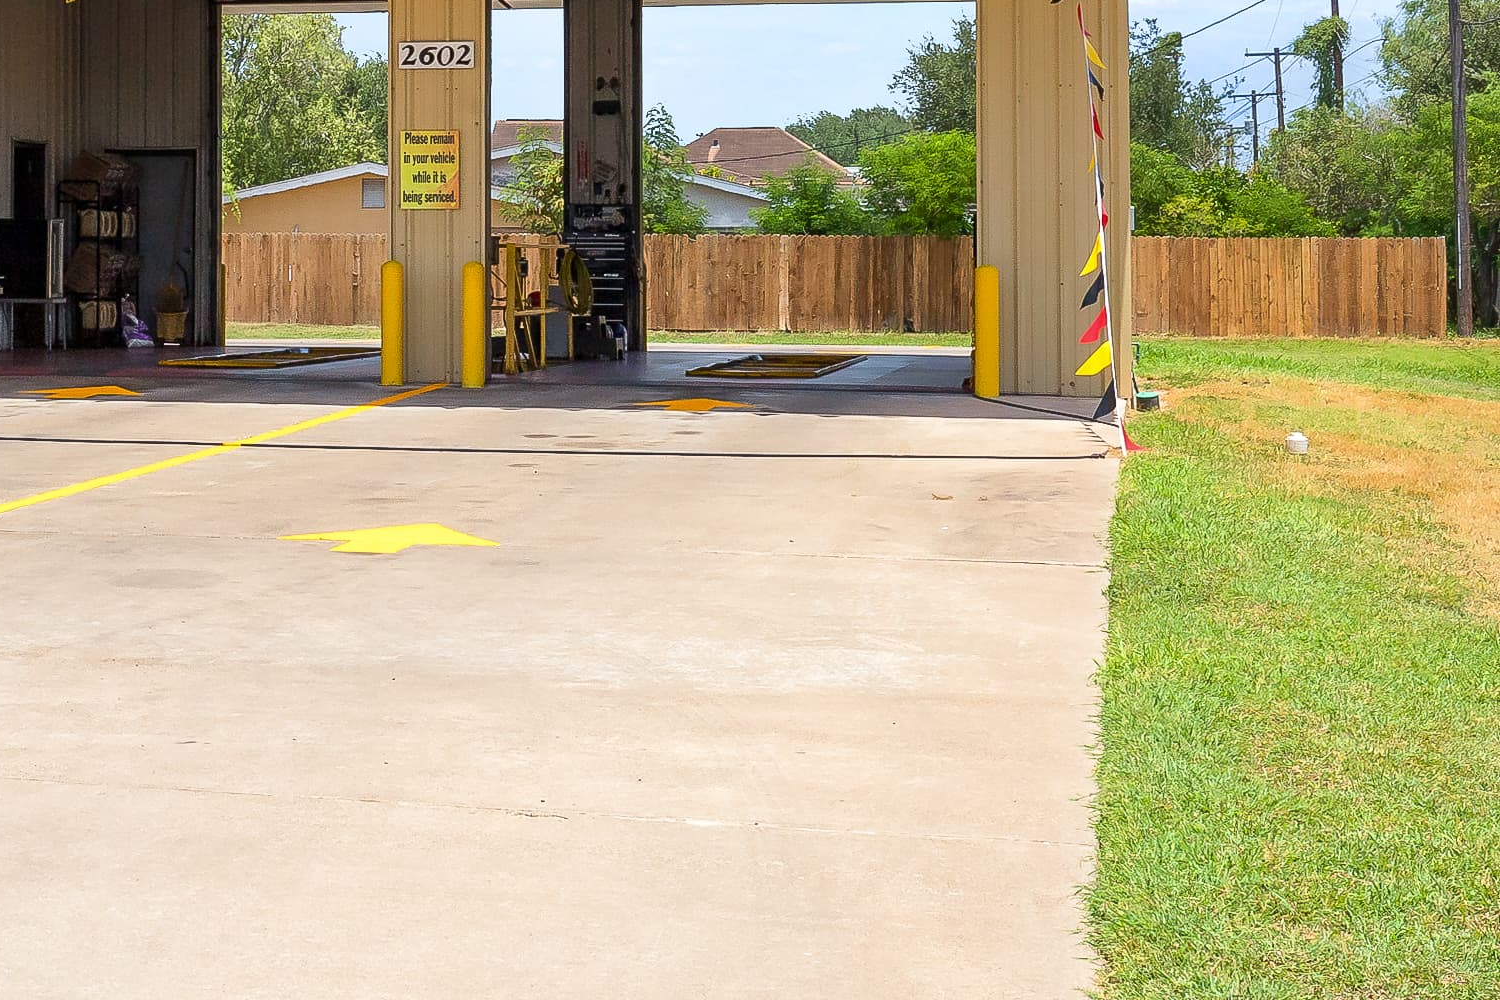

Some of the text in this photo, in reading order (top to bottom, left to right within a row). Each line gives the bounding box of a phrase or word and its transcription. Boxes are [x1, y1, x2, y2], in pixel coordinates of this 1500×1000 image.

[401, 44, 472, 67] 2602
[404, 131, 455, 145] Please remain
[403, 151, 456, 167] in your vehicle
[412, 170, 447, 184] while it is
[403, 190, 457, 206] being serviced.
